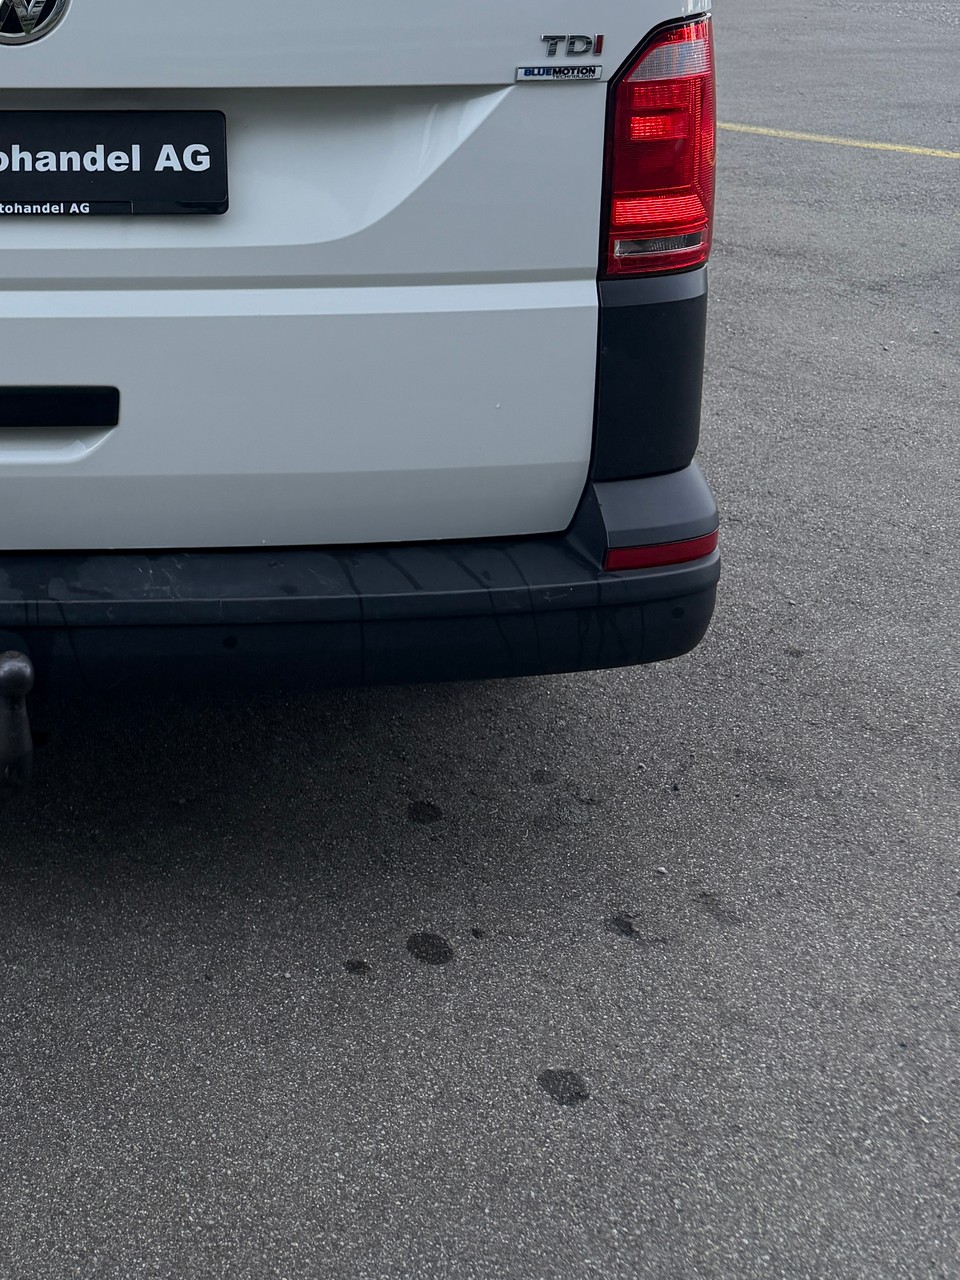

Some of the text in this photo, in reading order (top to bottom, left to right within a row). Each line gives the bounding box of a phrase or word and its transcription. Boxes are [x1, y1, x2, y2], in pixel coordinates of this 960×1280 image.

[540, 33, 604, 57] TDI
[523, 67, 596, 76] BLUEMOTION
[154, 143, 211, 172] AG
[69, 202, 91, 214] AG
